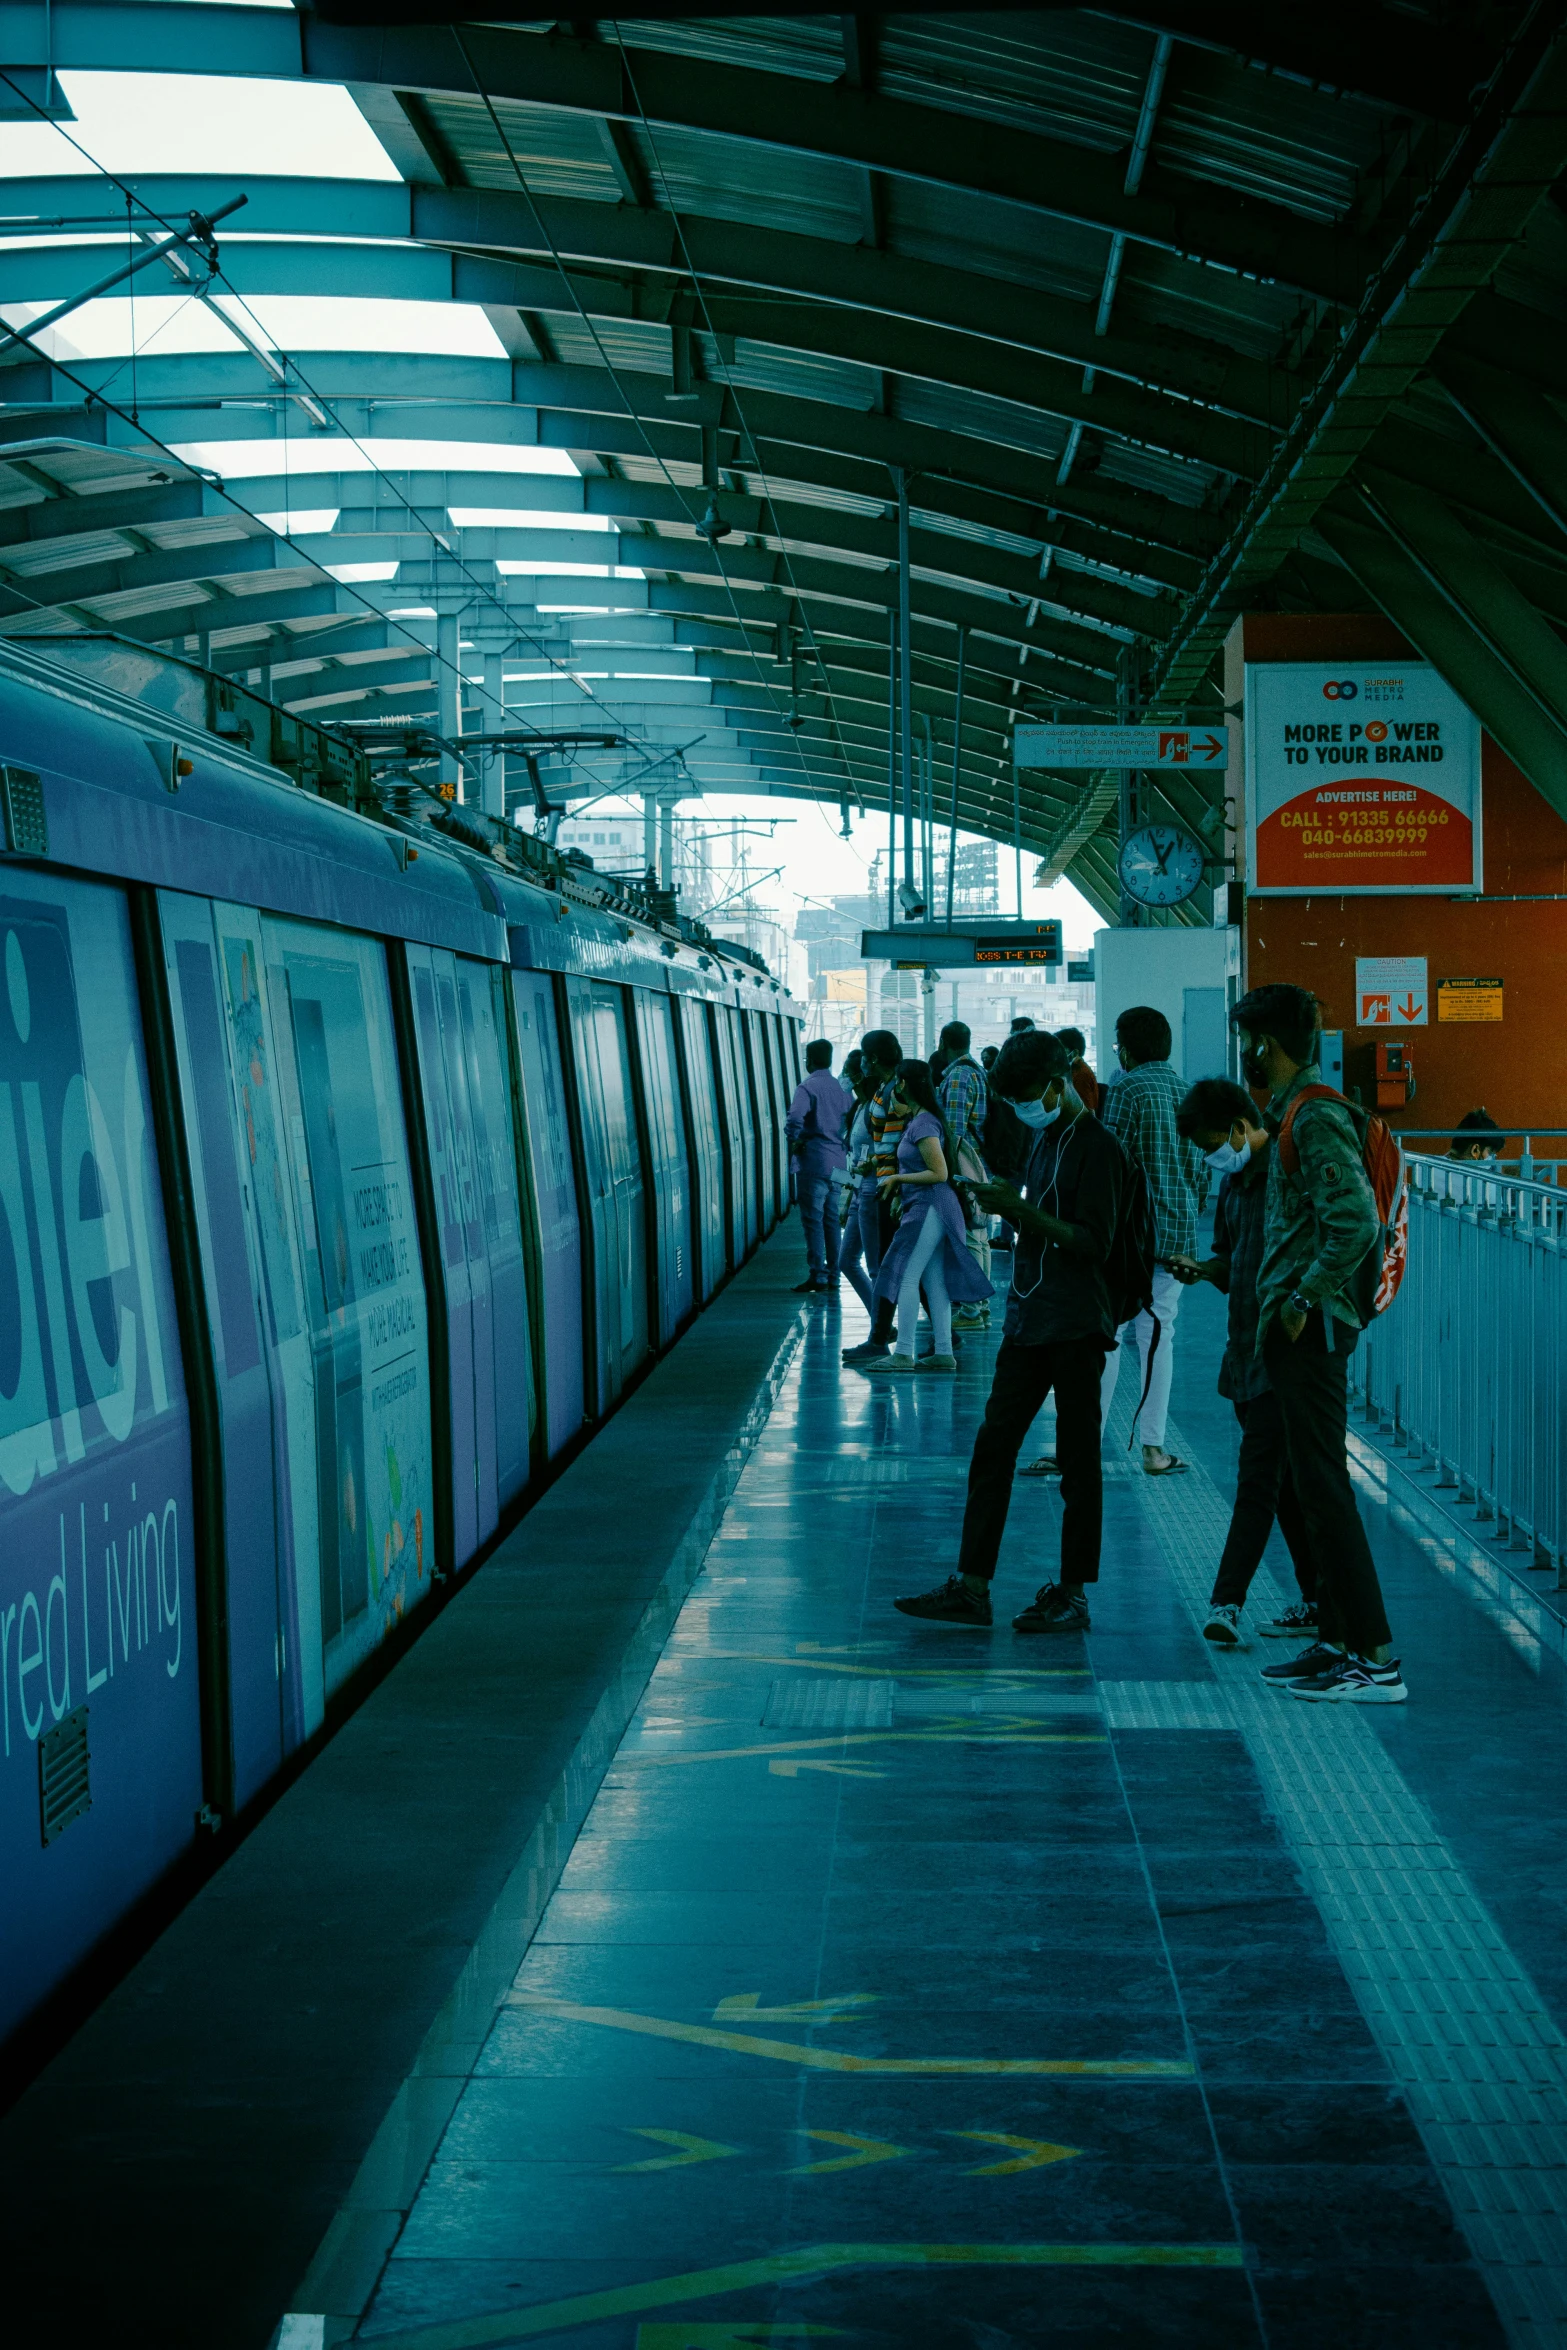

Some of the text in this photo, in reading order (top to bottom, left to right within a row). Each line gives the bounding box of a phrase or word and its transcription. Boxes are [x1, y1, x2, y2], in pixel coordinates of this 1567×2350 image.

[1284, 719, 1440, 743] MORE POWER
[1121, 739, 1156, 747] Emergency
[1284, 745, 1444, 764] TO YOUR BRAND
[439, 783, 455, 795] 26
[1315, 790, 1417, 803] ADVERTISE HERE!
[1280, 811, 1322, 827] CALL
[1338, 811, 1389, 826] 91335
[1395, 809, 1449, 825] 66666
[1155, 828, 1165, 838] 12
[1302, 828, 1428, 845] 040-66839999
[1185, 843, 1193, 853] 2
[1303, 850, 1427, 860] sales@surabhimetromedia.com
[1125, 860, 1133, 869] 9
[1190, 858, 1198, 868] 3
[1130, 875, 1137, 885] 8
[1185, 874, 1193, 883] 4
[1142, 887, 1149, 896] 7
[1158, 891, 1166, 900] 6
[1175, 886, 1182, 895] 5
[352, 1181, 403, 1229] MORE SPACE TO
[360, 1246, 381, 1290] MAKE
[394, 1237, 411, 1278] LIFE
[367, 1304, 388, 1350] MORE
[81, 1481, 181, 1697] Living
